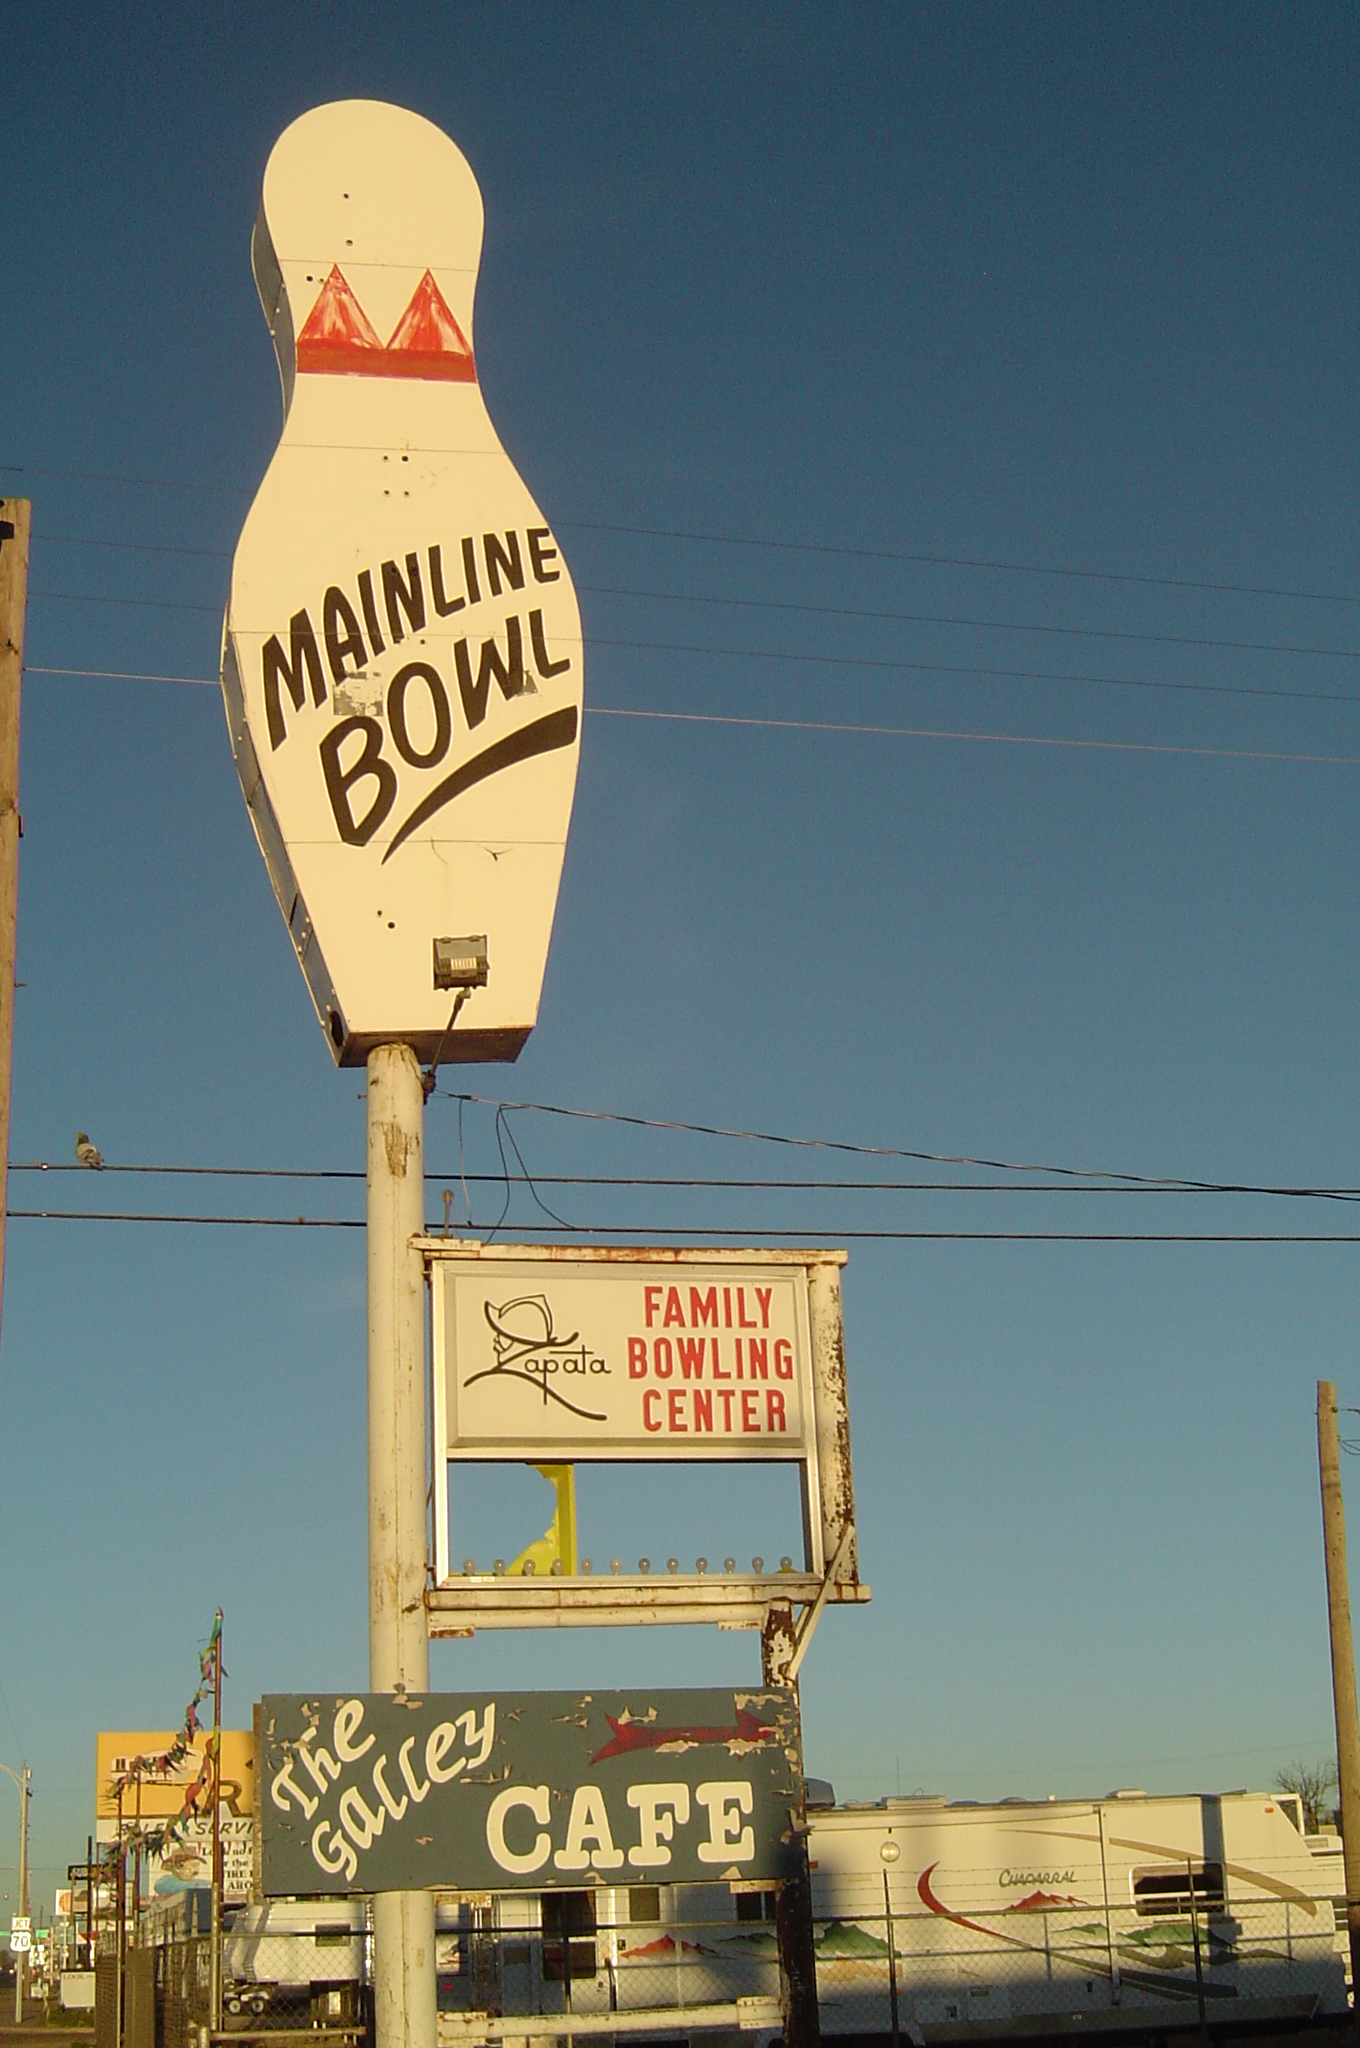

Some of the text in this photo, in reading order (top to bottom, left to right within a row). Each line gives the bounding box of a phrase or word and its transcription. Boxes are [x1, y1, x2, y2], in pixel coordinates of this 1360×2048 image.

[262, 527, 560, 752] MAINLINE
[319, 608, 571, 847] BOWL
[643, 1285, 773, 1328] FAMILY
[463, 1330, 612, 1420] Zapata
[627, 1337, 794, 1380] BOWLING
[642, 1389, 788, 1432] CENTER
[270, 1698, 376, 1820] The
[310, 1702, 496, 1882] Galley
[486, 1781, 755, 1874] CAFE
[12, 1935, 29, 1948] 70
[14, 1919, 29, 1928] JCT
